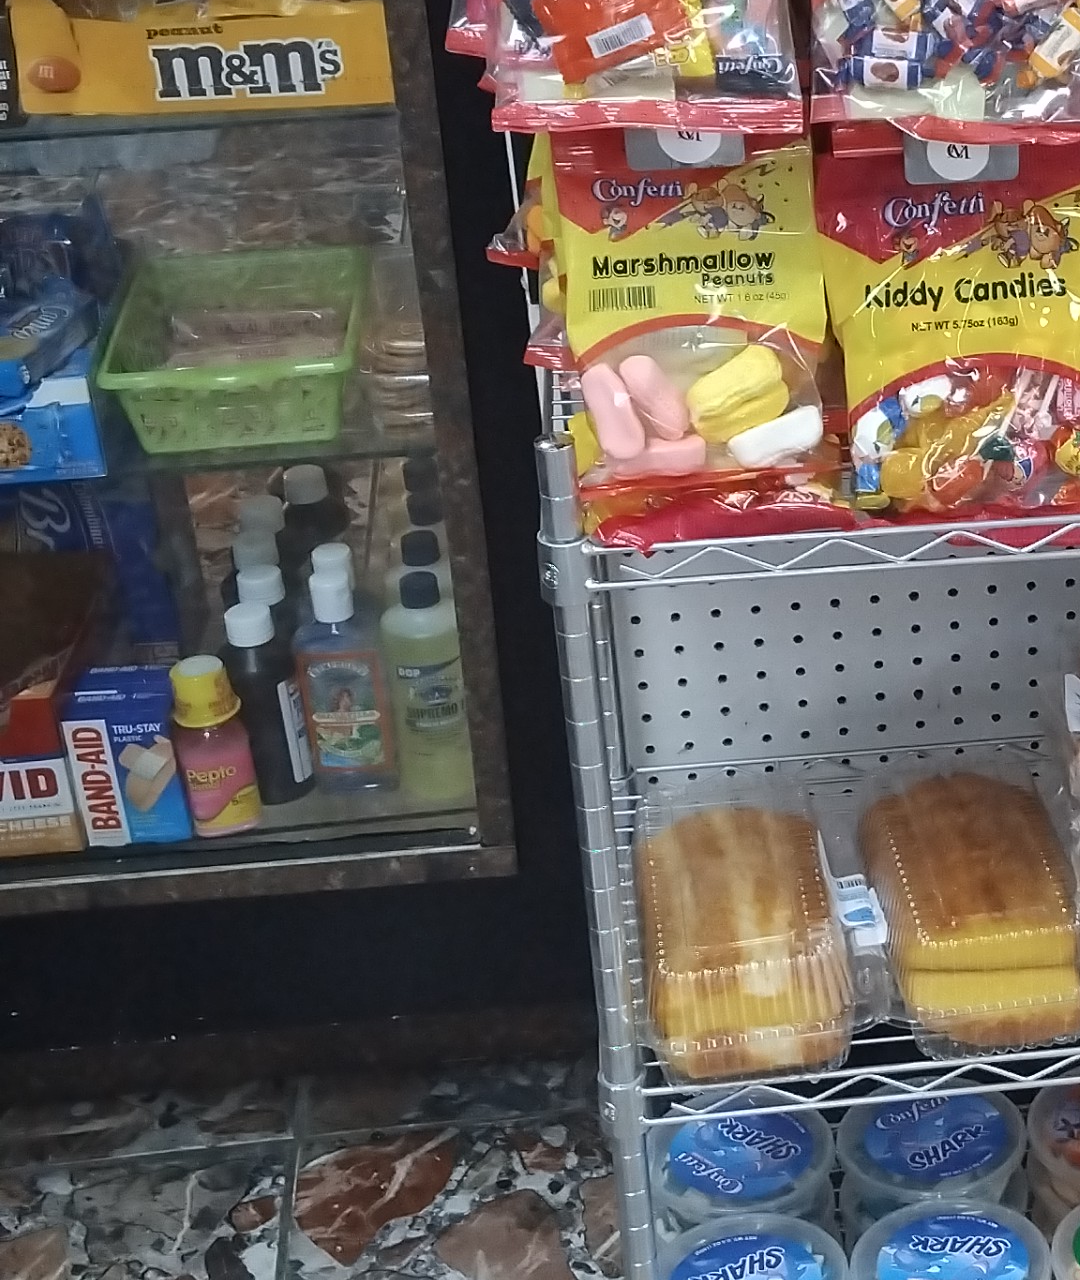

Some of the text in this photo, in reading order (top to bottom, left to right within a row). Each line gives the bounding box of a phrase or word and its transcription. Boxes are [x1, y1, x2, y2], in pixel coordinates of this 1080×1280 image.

[145, 22, 224, 40] peanut
[151, 39, 342, 99] m&m's
[592, 177, 684, 207] Confetti
[883, 190, 985, 228] Confetti
[591, 249, 776, 279] Marshmallow
[701, 270, 775, 287] Peanuts
[694, 293, 714, 304] NET
[716, 294, 735, 304] WT
[864, 271, 1068, 313] Kiddy Candies
[911, 321, 932, 332] NET
[934, 320, 950, 331] WT
[987, 315, 1019, 330] (163g)
[111, 722, 162, 735] TRU-STAY
[71, 726, 123, 831] BAND-AID
[187, 765, 237, 786] Pepto
[718, 1117, 801, 1162] SHARK
[907, 1123, 991, 1171] SHARK
[673, 1152, 745, 1196] Confetti
[909, 1233, 1012, 1258] SHARK
